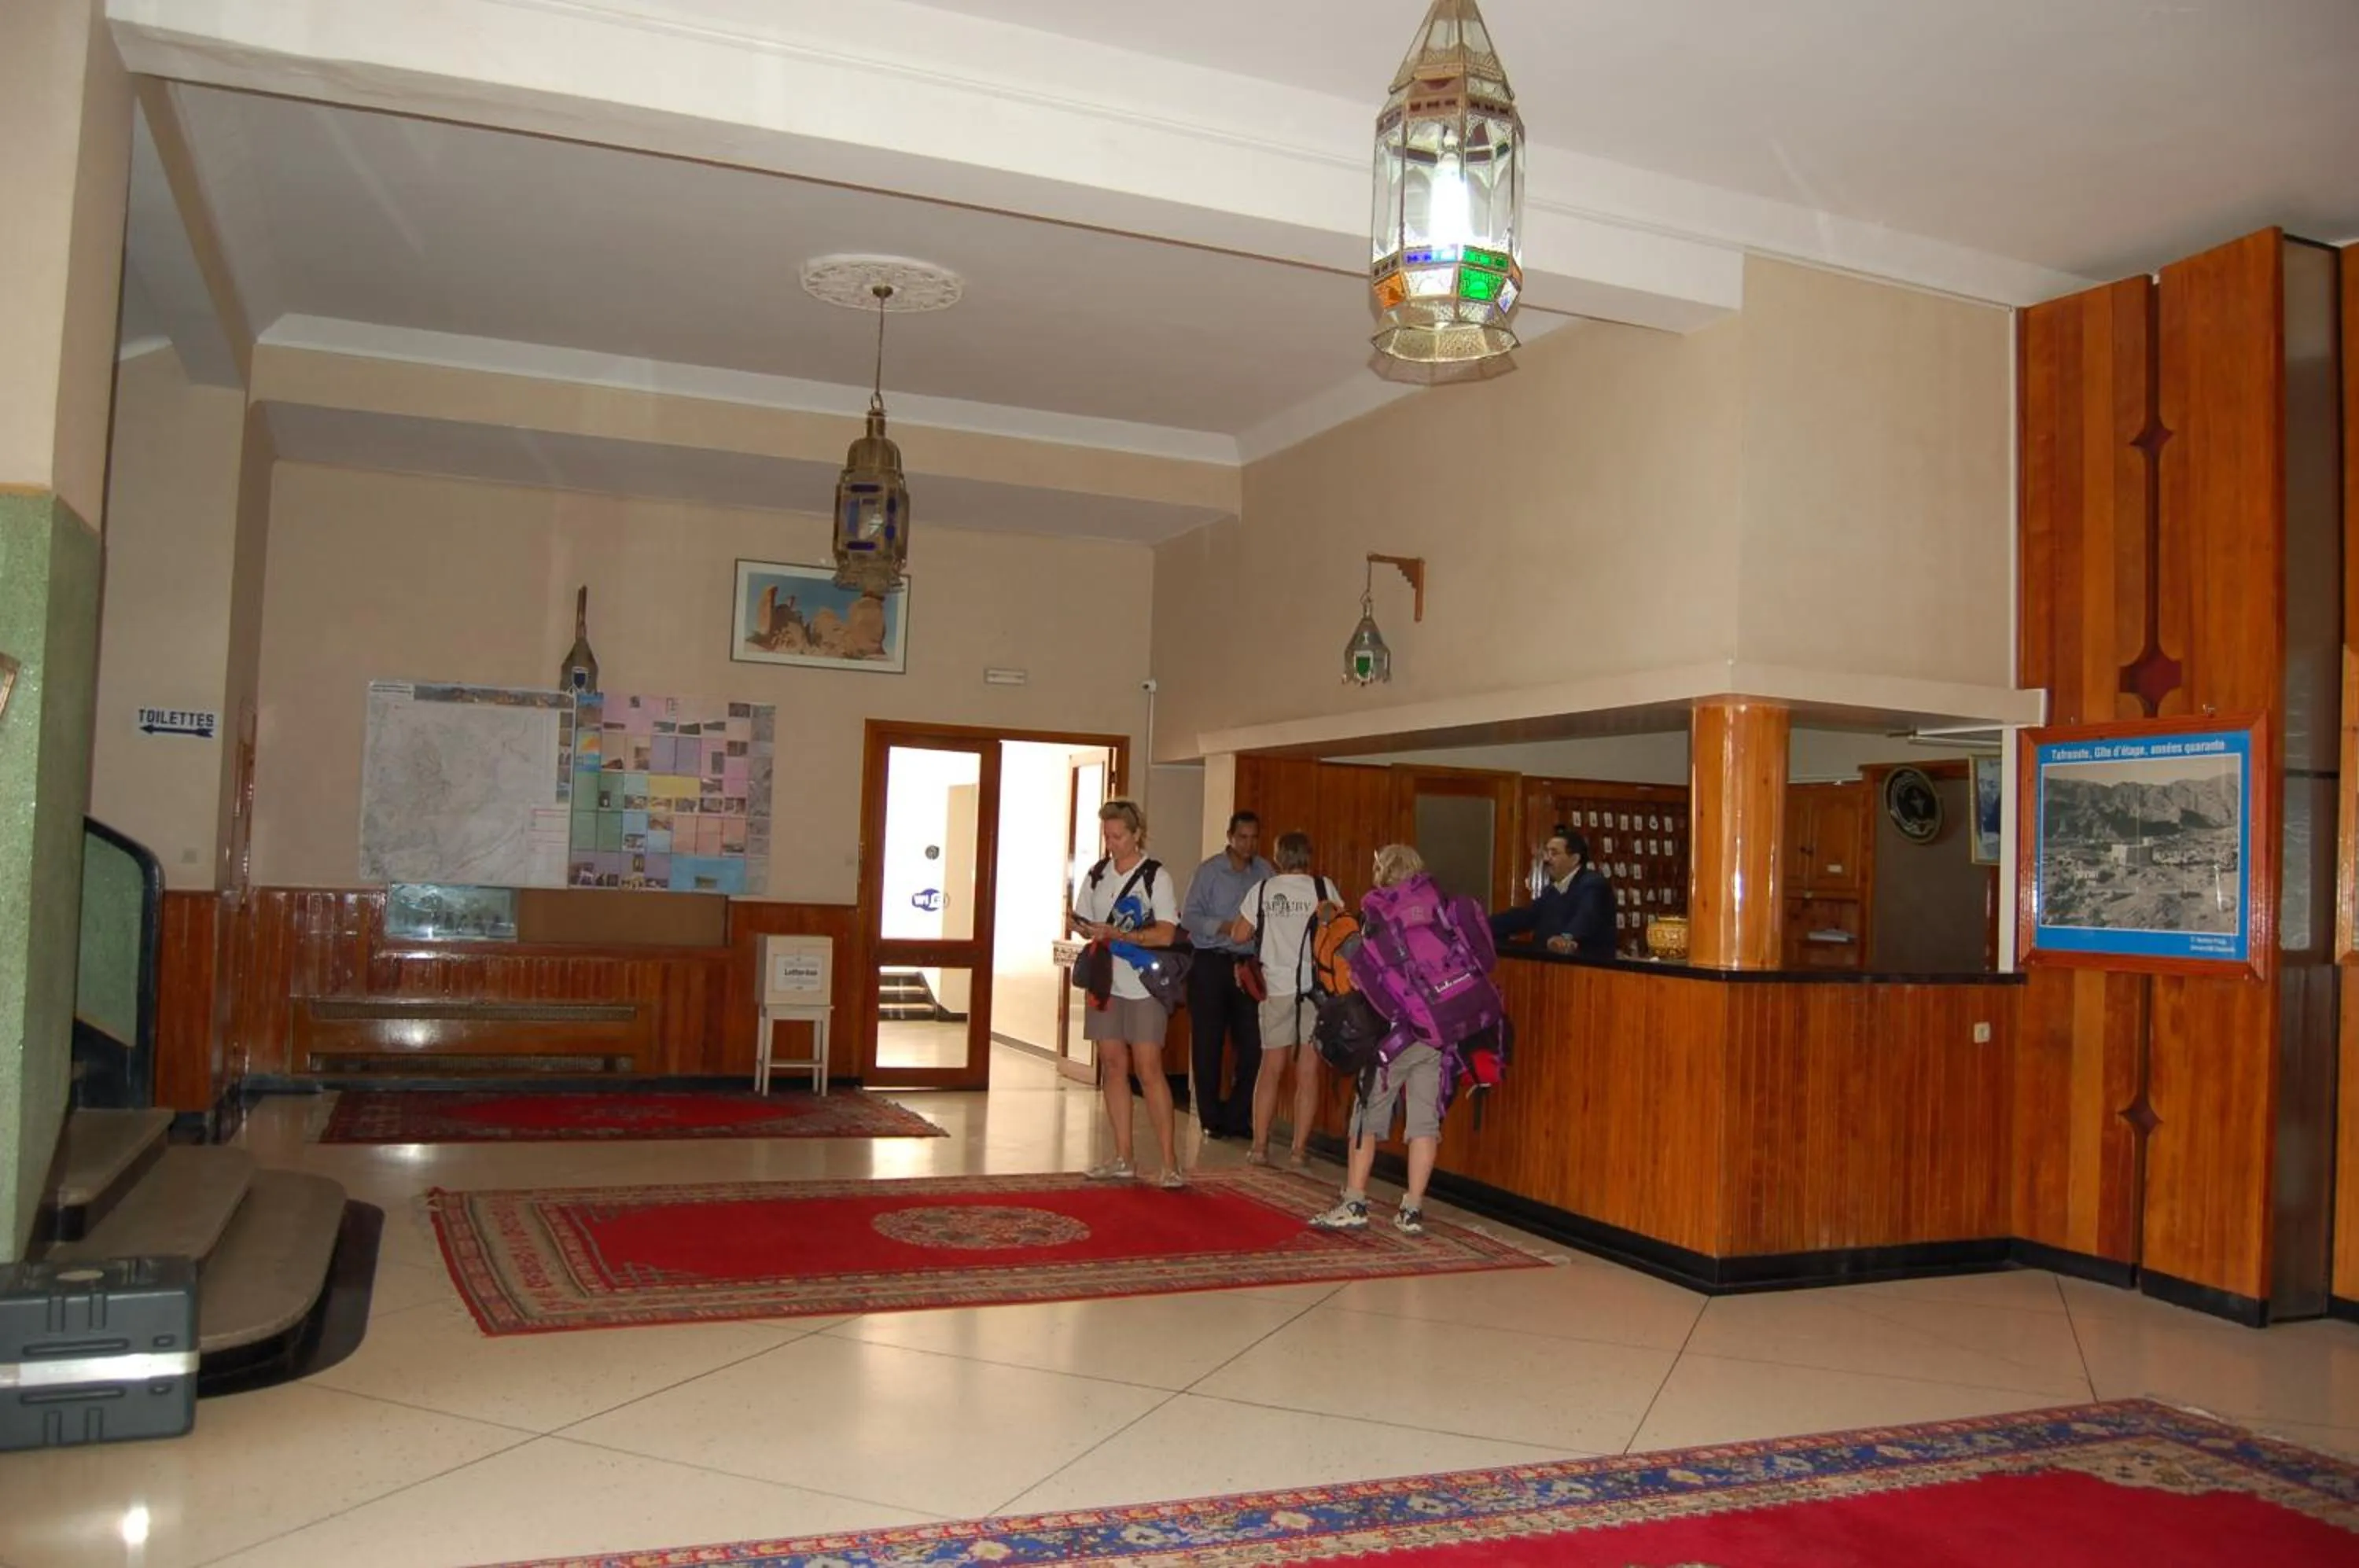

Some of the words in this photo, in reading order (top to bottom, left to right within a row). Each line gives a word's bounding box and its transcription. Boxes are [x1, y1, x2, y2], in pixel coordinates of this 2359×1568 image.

[139, 709, 214, 727] TOILETTES
[2151, 742, 2182, 755] années
[2184, 739, 2225, 754] quarante
